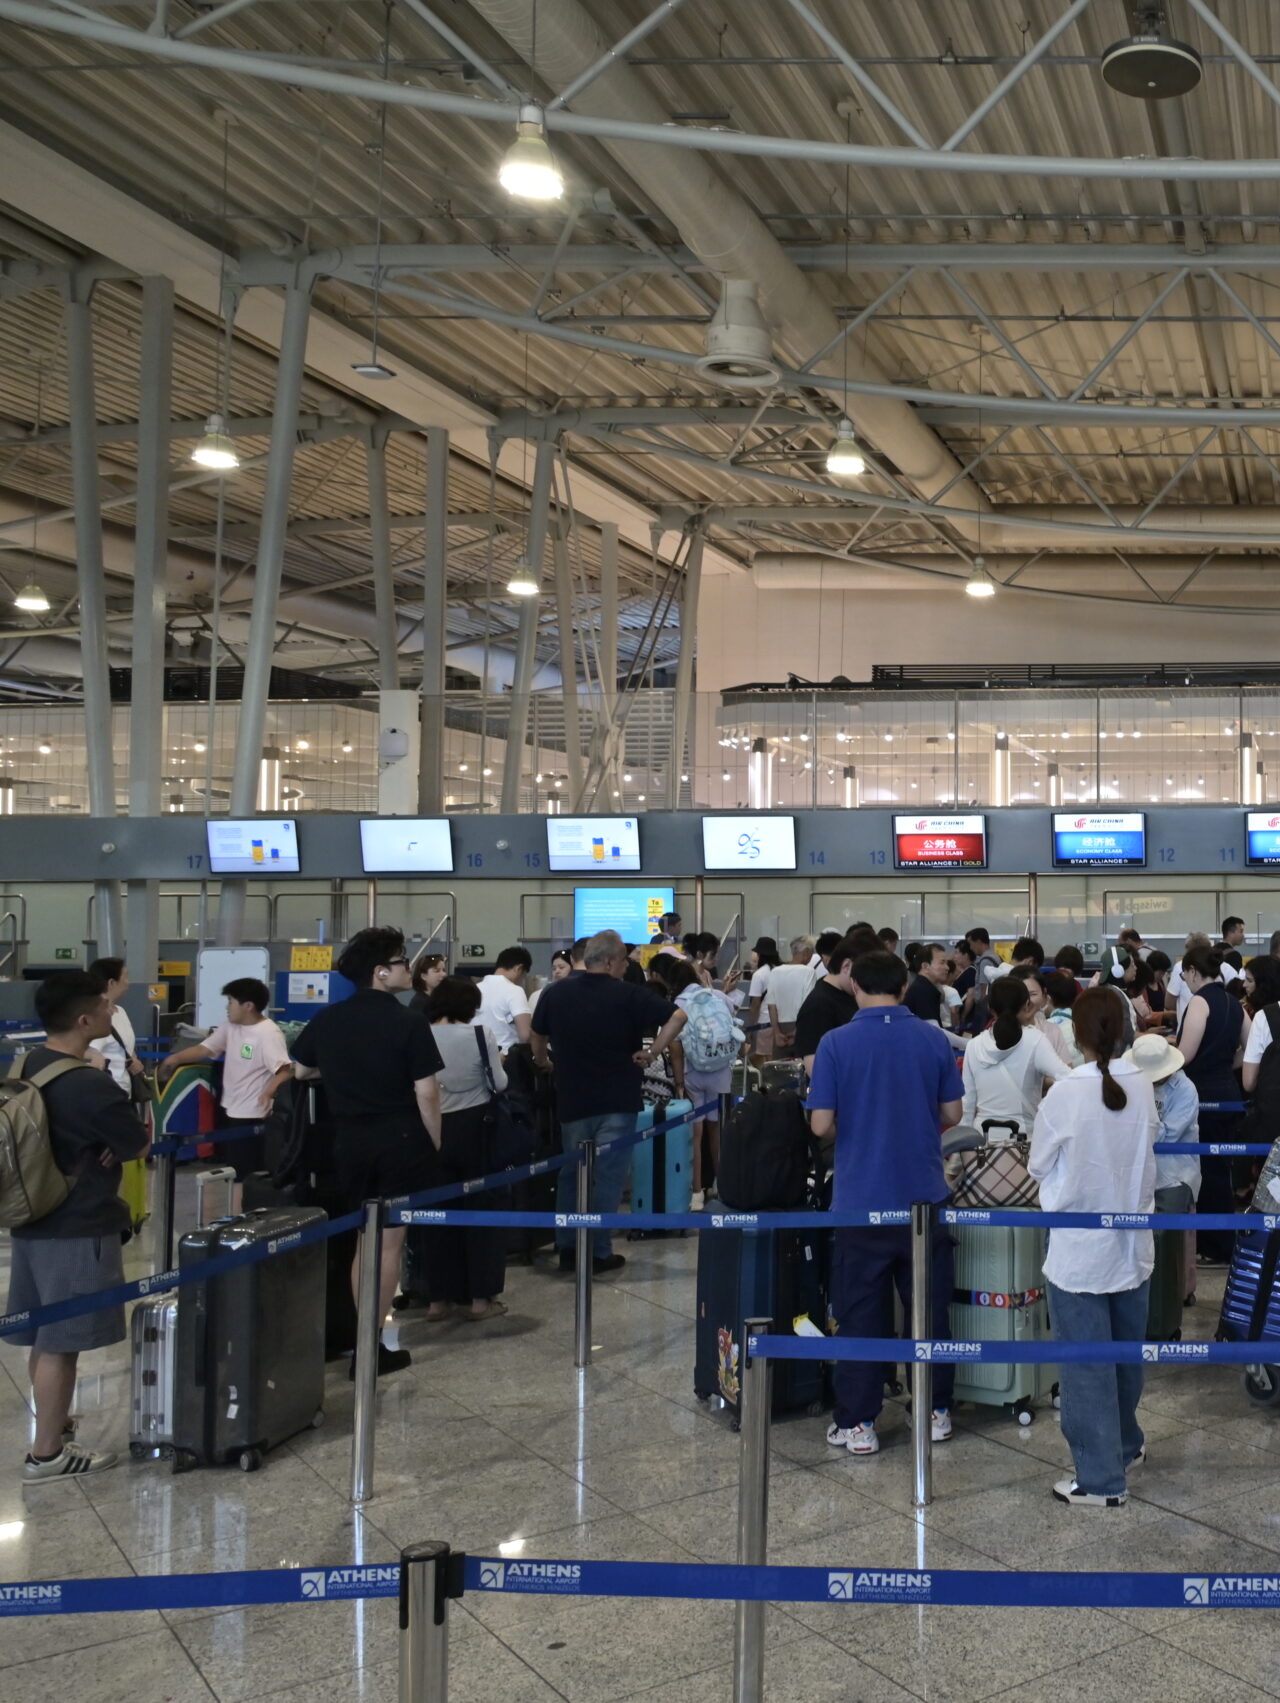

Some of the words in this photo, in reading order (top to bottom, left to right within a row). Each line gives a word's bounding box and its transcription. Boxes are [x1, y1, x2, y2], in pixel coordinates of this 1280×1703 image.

[467, 854, 483, 867] 16
[524, 854, 540, 867] 15
[809, 851, 825, 865] 14
[870, 851, 885, 864] 13
[1159, 848, 1175, 862] 12
[1219, 848, 1235, 862] 11
[187, 856, 202, 869] 17
[413, 1211, 446, 1219] ATHENS
[568, 1214, 602, 1222] ATHENS
[724, 1214, 758, 1222] ATHENS
[882, 1211, 911, 1219] ATHEN
[957, 1211, 990, 1219] ATHENS
[150, 1270, 180, 1285] ATHENS
[0, 1311, 30, 1325] THENS
[933, 1343, 982, 1352] ATHENS
[1160, 1344, 1209, 1354] ATHENS
[327, 1567, 400, 1583] ATHENS
[507, 1563, 581, 1578] ATHENS
[856, 1573, 932, 1587] ATHENS
